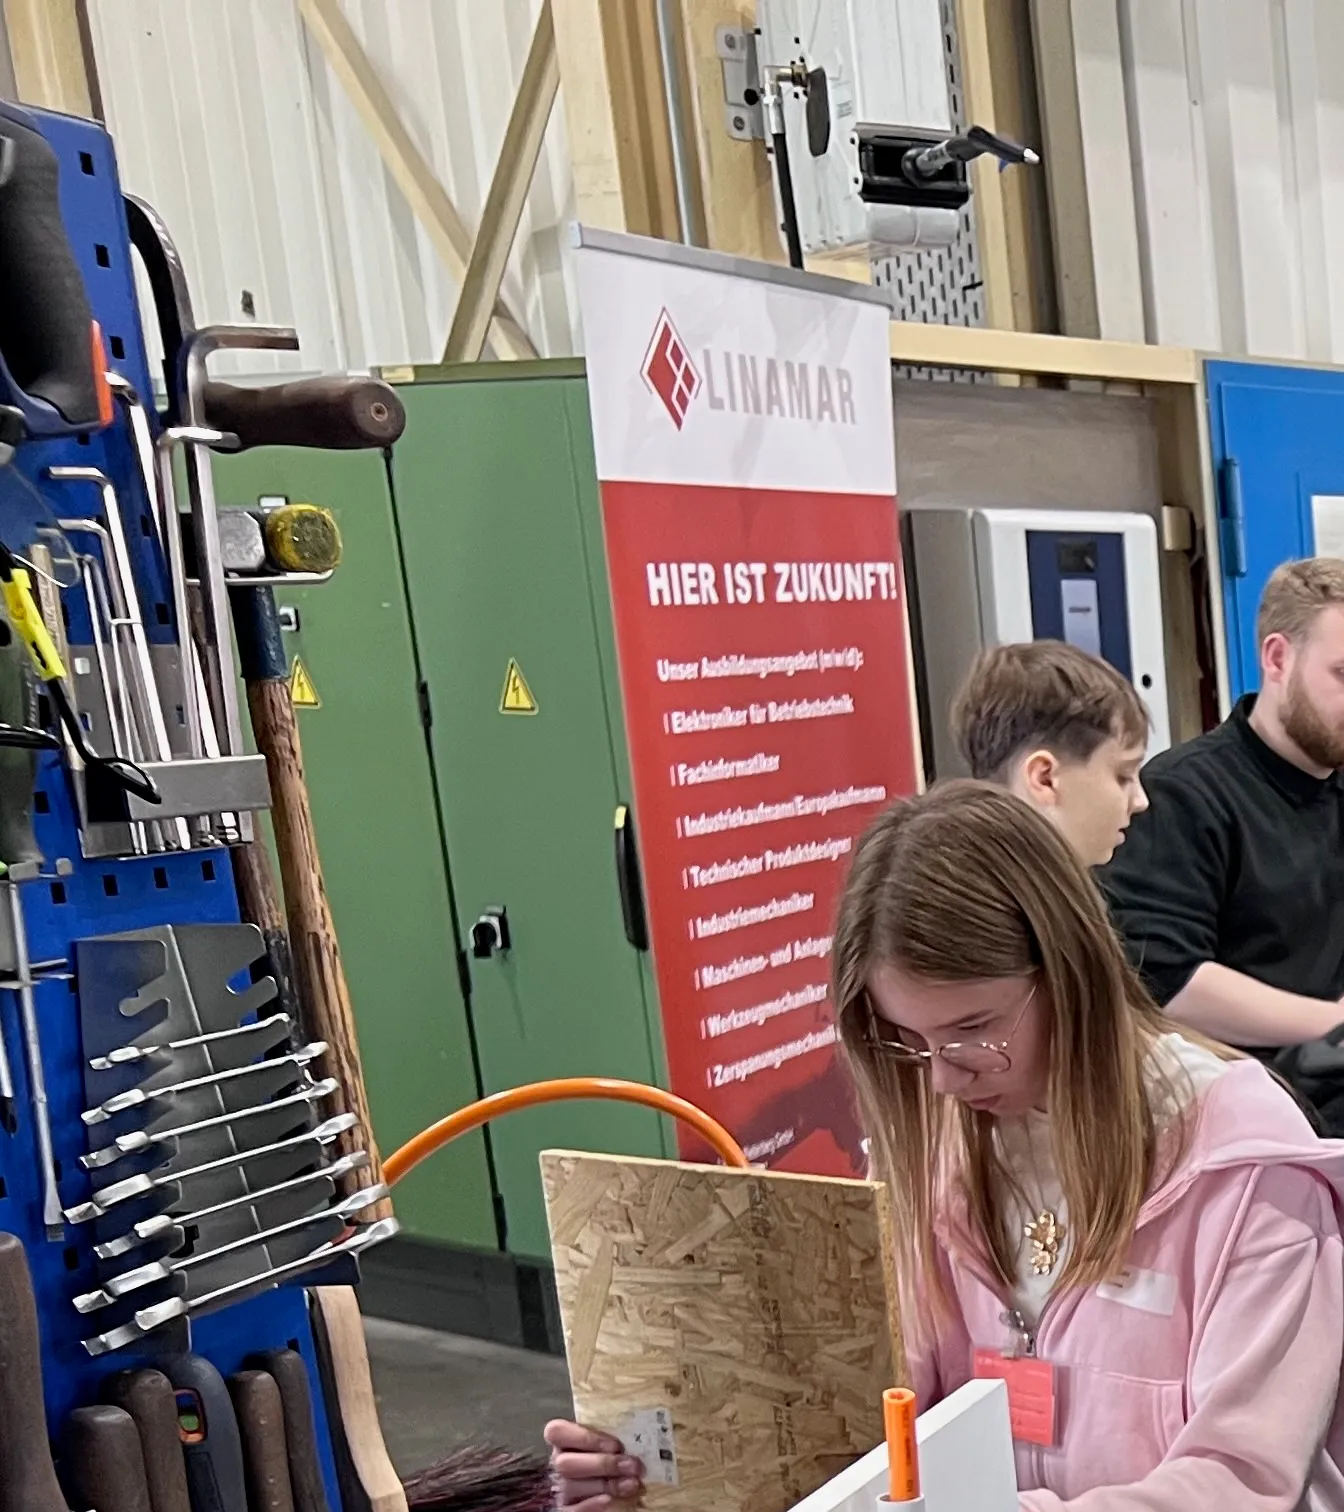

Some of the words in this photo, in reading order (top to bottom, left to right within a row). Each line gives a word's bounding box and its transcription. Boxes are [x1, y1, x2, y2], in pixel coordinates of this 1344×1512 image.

[703, 348, 856, 425] LINAMAR
[646, 562, 719, 606] HIER
[723, 562, 767, 604] IST
[773, 562, 898, 603] ZUKUNFT!
[656, 659, 699, 682] Unser
[701, 650, 818, 679] Ausbildungsangebot
[671, 706, 748, 734] Elektroniker
[749, 703, 767, 724] für
[768, 693, 854, 722] Betriebstechnik
[677, 752, 781, 786] Fachinformatiker
[689, 855, 764, 889] Technischer
[764, 836, 852, 872] Produktdesigner
[696, 891, 815, 939] Industriemechaniker
[701, 955, 769, 989] Maschinen-
[769, 942, 793, 968] und
[706, 983, 828, 1038] Werkzeugmechaniker
